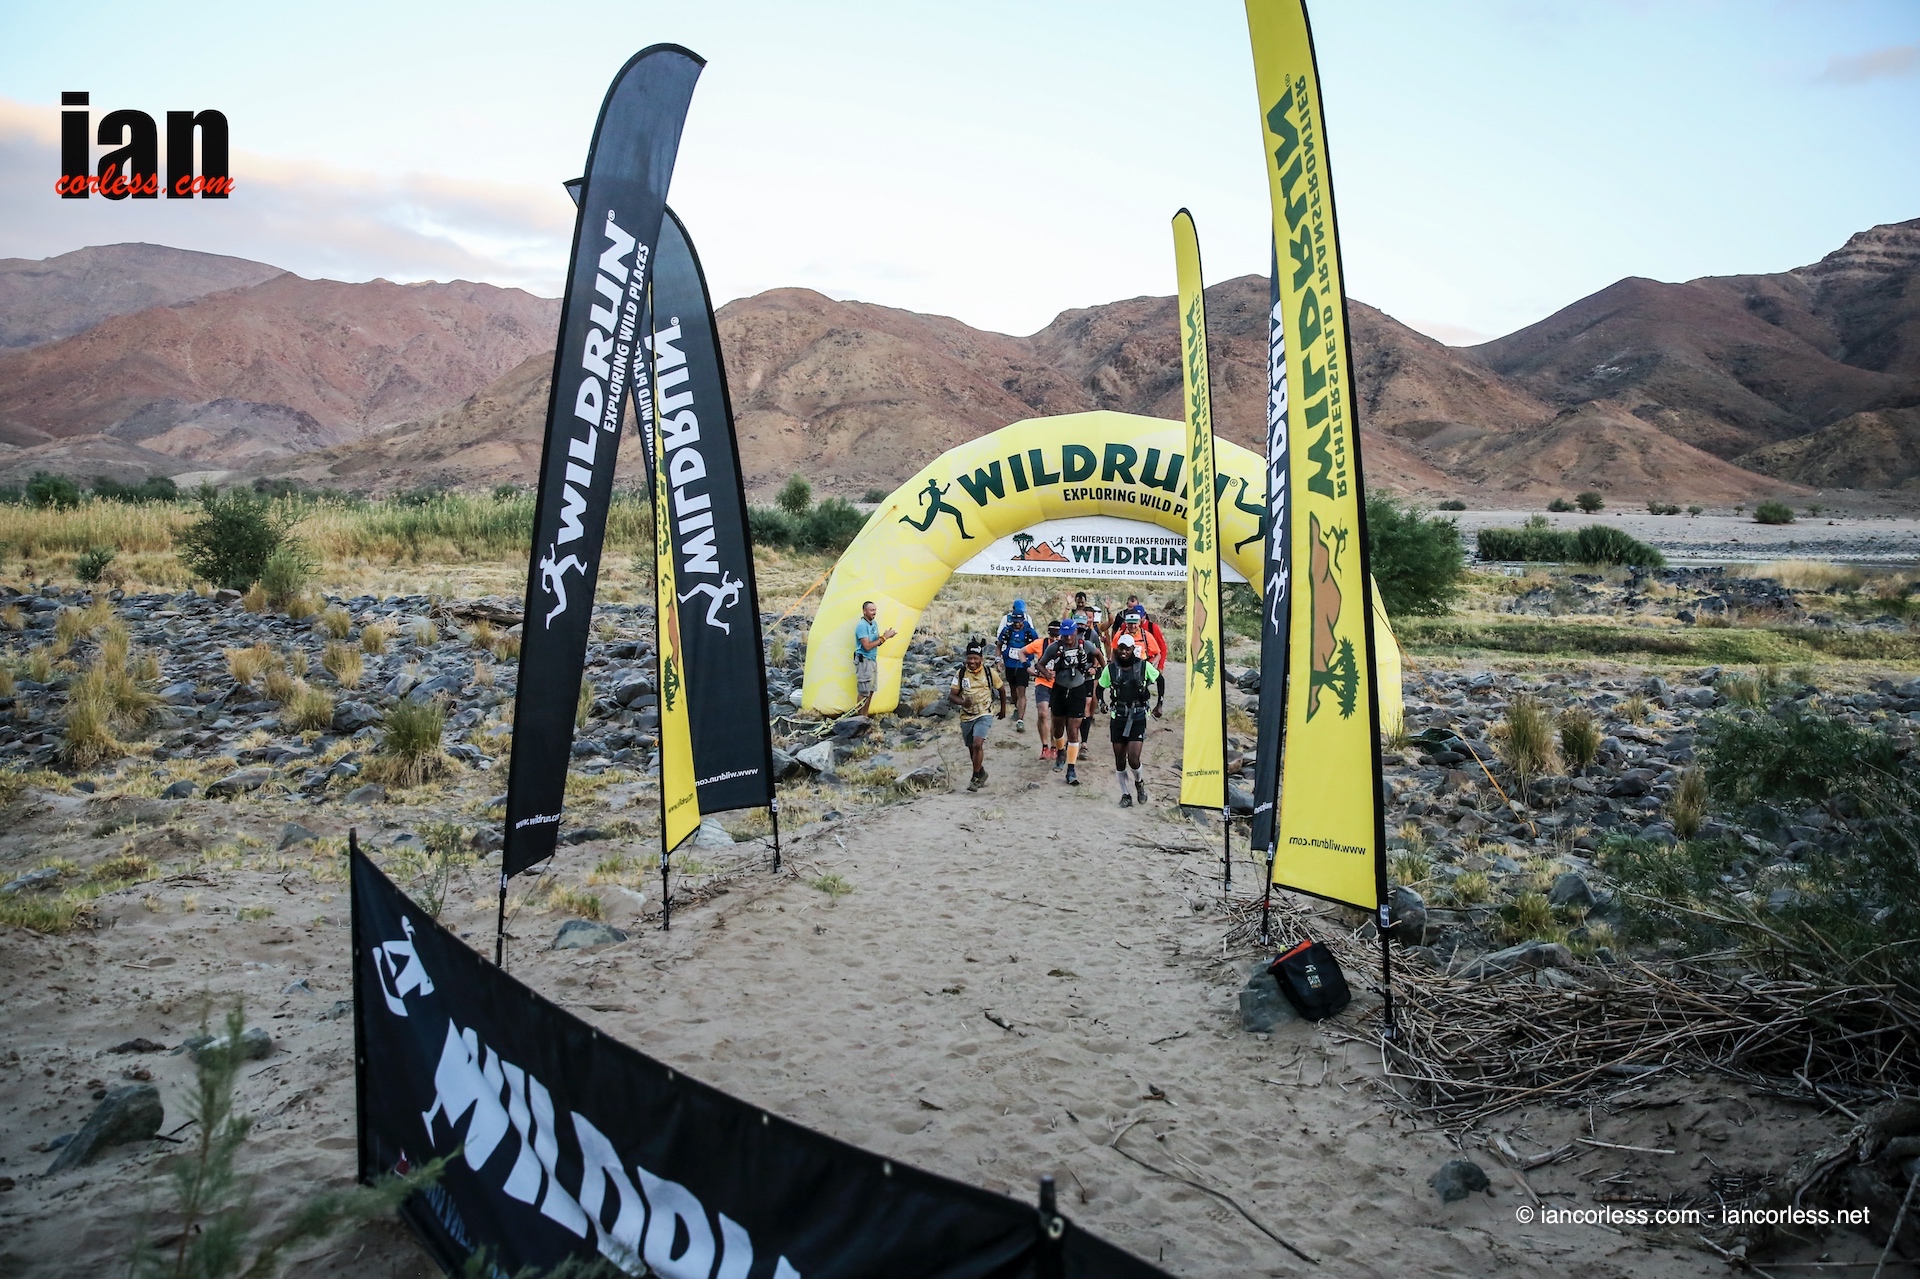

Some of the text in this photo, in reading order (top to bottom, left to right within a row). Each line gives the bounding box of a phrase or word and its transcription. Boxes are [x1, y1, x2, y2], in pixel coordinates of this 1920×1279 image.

[603, 242, 650, 434] EXPLORING WILD PLACES
[1063, 488, 1136, 504] EXPLORING
[1140, 492, 1172, 513] WILD
[1071, 535, 1187, 546] RICHTERSVELD TRANSFRONTIER
[1071, 546, 1187, 566] WILDRUN
[996, 564, 1016, 573] days,
[1022, 565, 1052, 573] African
[1052, 567, 1091, 575] countries,
[1127, 569, 1166, 577] mountain
